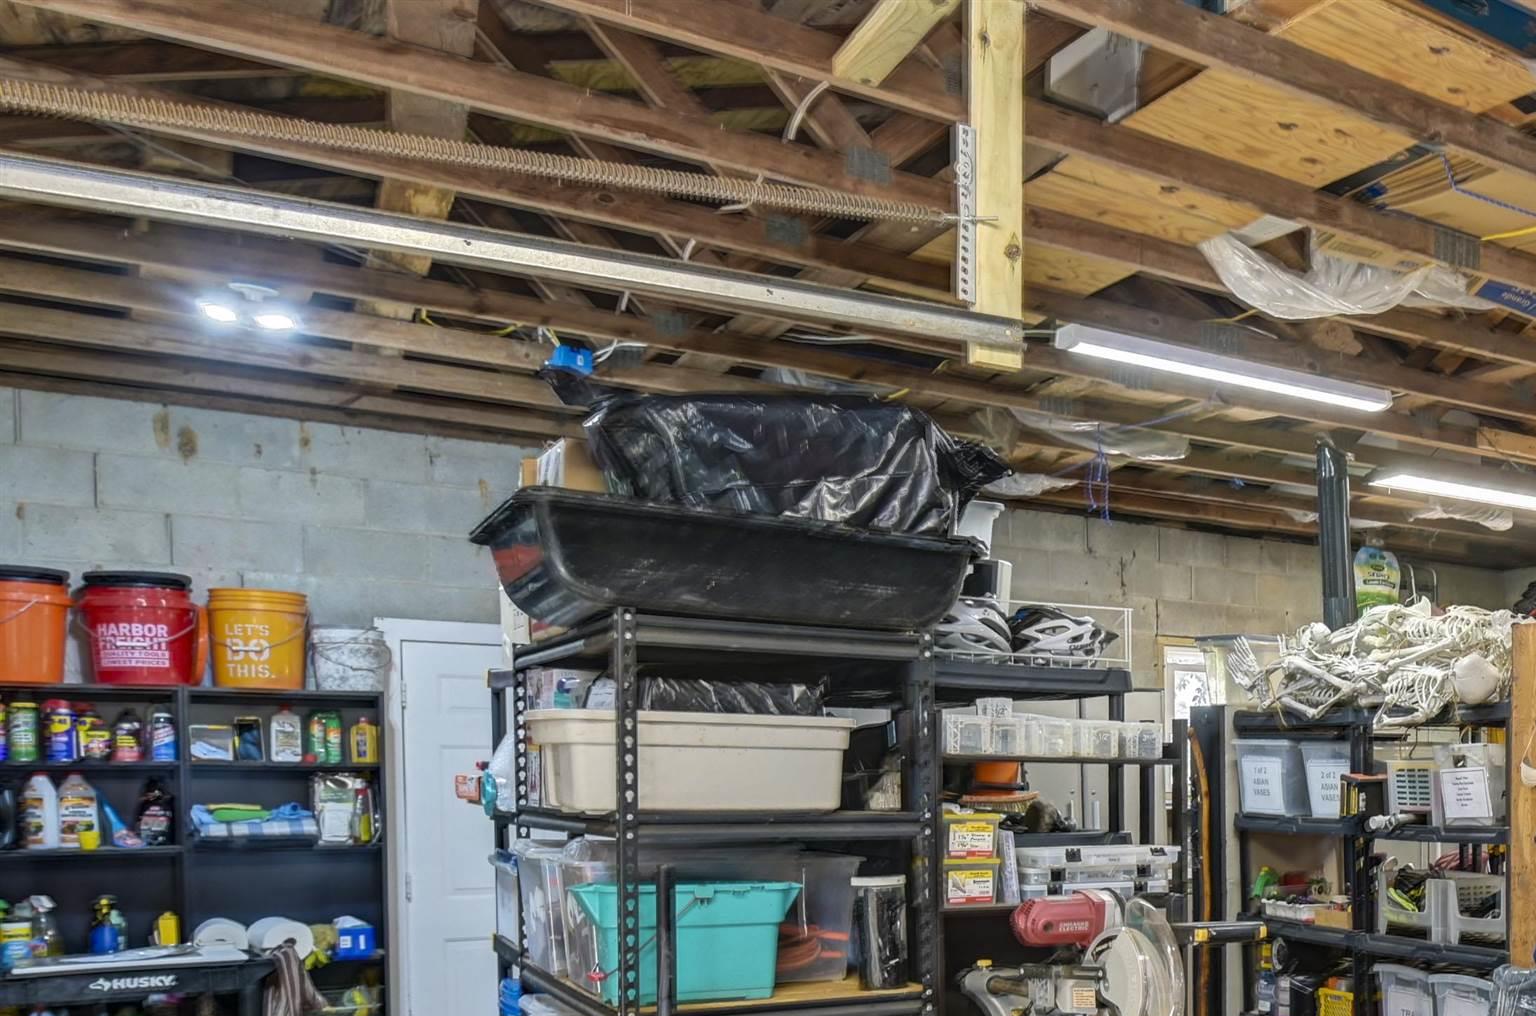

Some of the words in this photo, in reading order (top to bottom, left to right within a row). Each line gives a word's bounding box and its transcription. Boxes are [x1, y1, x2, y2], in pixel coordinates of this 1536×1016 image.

[96, 623, 168, 637] HARBOR
[225, 623, 271, 636] LET'S
[226, 638, 272, 661] DO
[227, 663, 277, 679] THIS.
[1253, 789, 1271, 797] VASES
[1320, 783, 1338, 791] ASIAN
[112, 974, 178, 989] HUSKY
